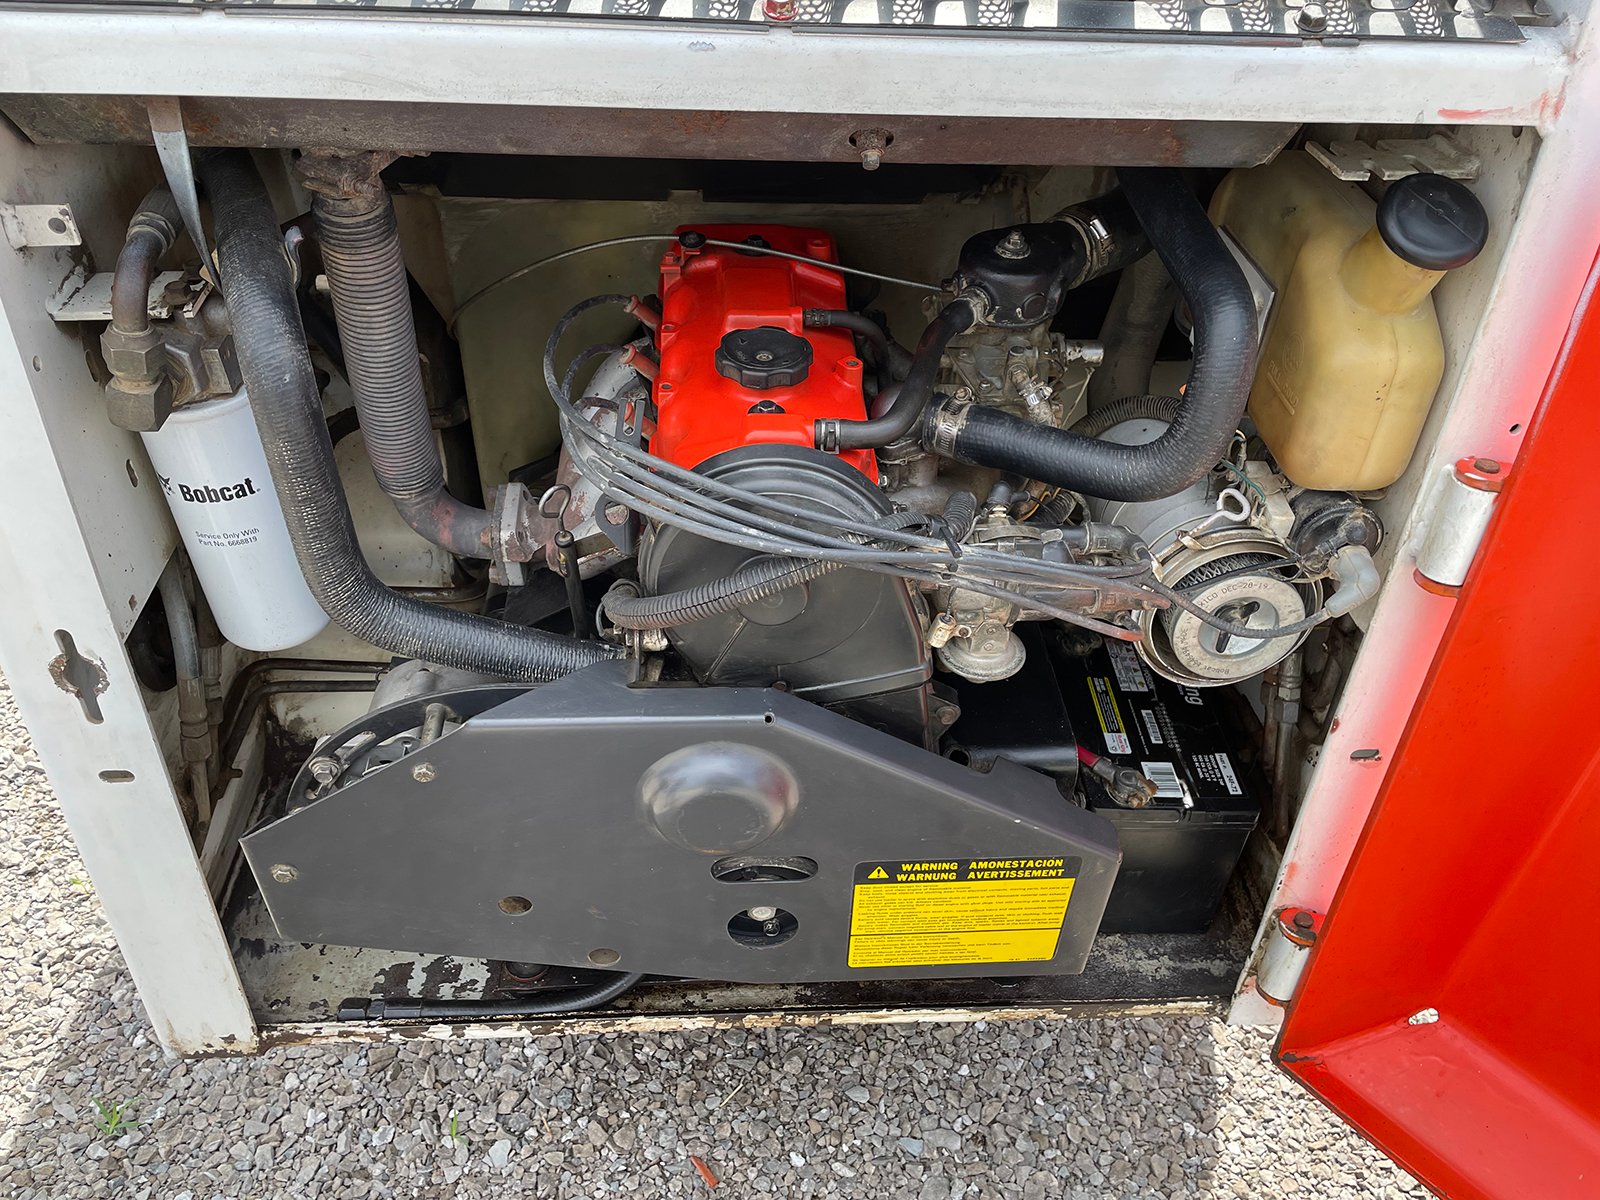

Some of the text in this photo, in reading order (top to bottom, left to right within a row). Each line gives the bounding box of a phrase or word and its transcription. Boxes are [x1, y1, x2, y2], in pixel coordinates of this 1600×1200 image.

[178, 477, 257, 504] Bobcat
[195, 527, 260, 540] Service Only With
[198, 538, 214, 547] Part
[901, 862, 959, 872] WARNING
[896, 869, 1065, 882] WARNUNG AVERTISSEMENT
